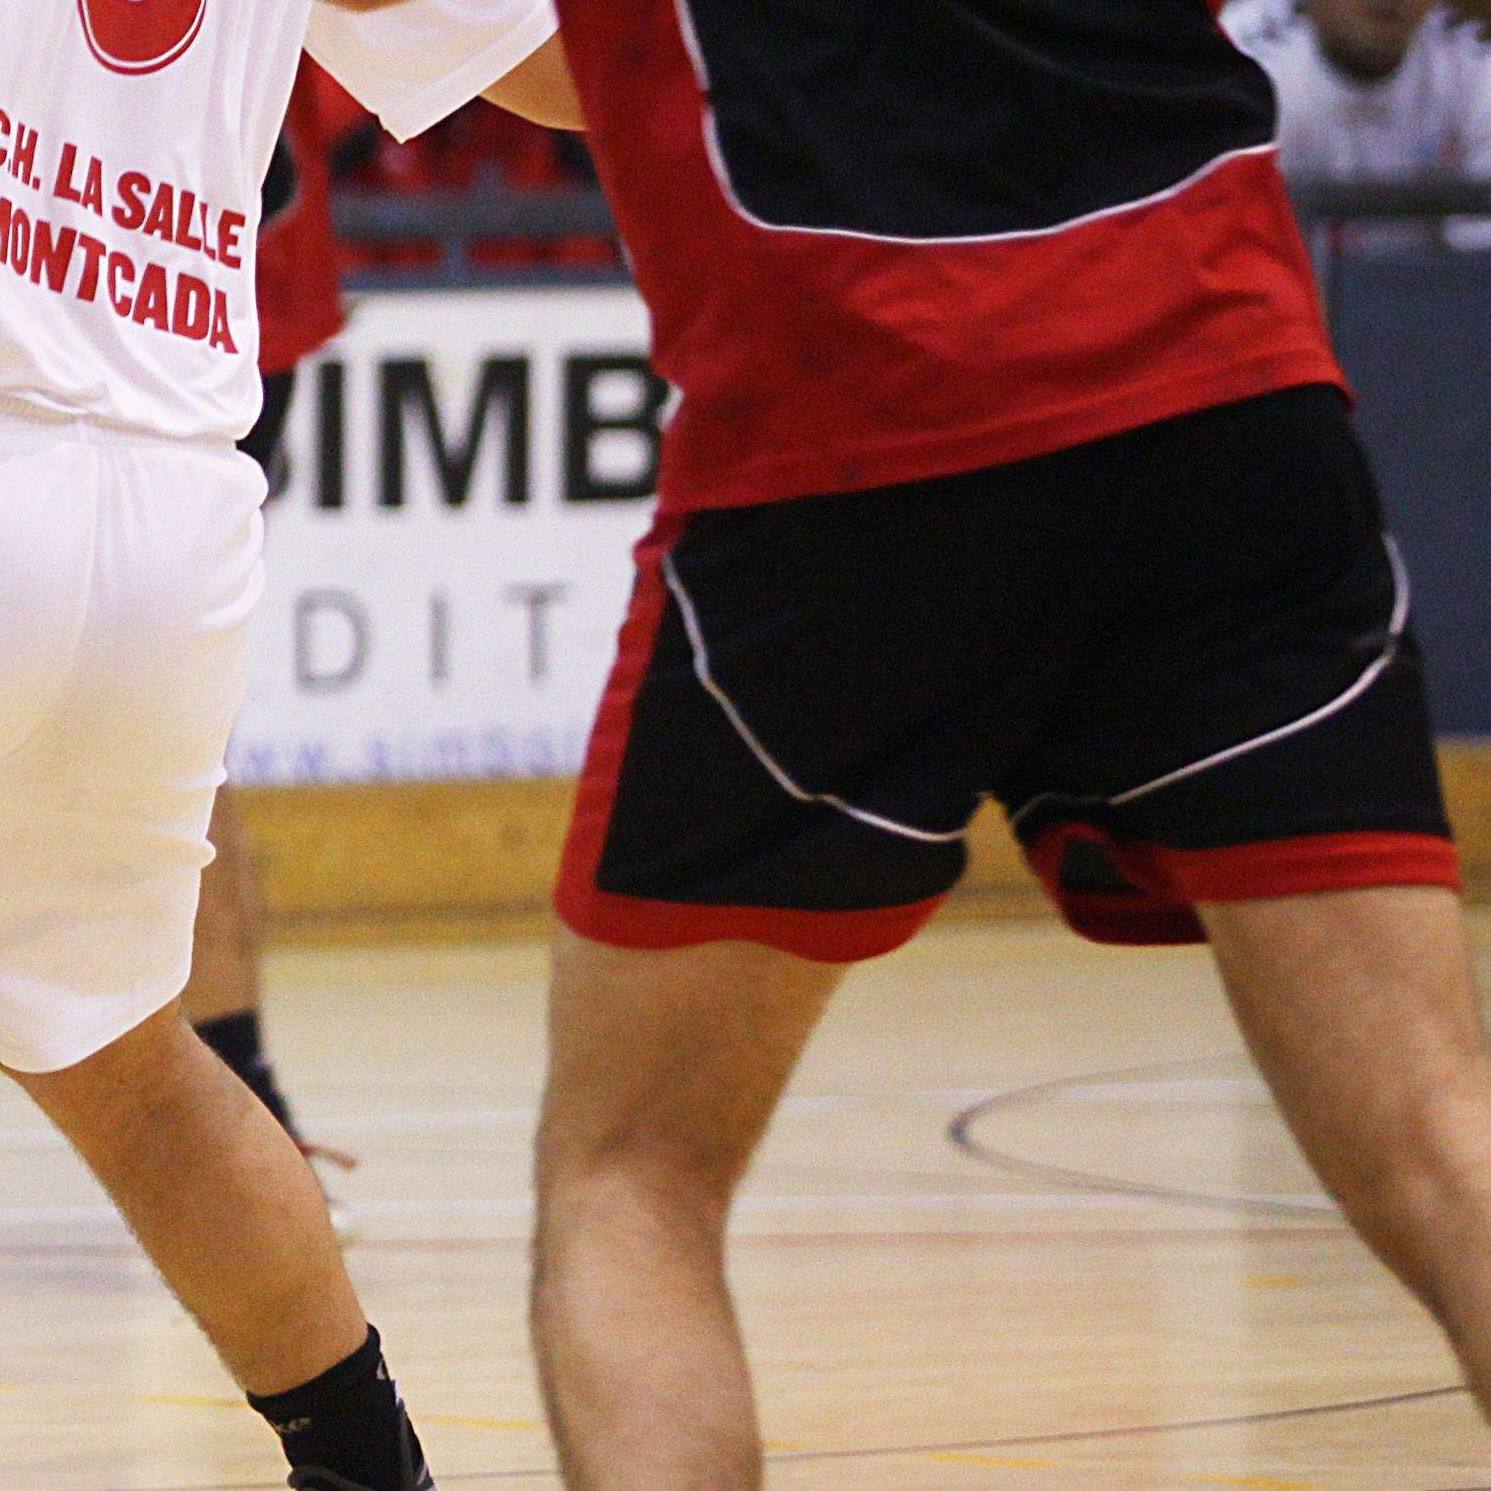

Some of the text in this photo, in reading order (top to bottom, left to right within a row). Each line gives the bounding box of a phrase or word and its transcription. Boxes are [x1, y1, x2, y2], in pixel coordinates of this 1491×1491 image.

[52, 142, 104, 218] LA
[111, 170, 247, 270] SALLE
[268, 349, 670, 508] IMB
[293, 579, 574, 697] DIT
